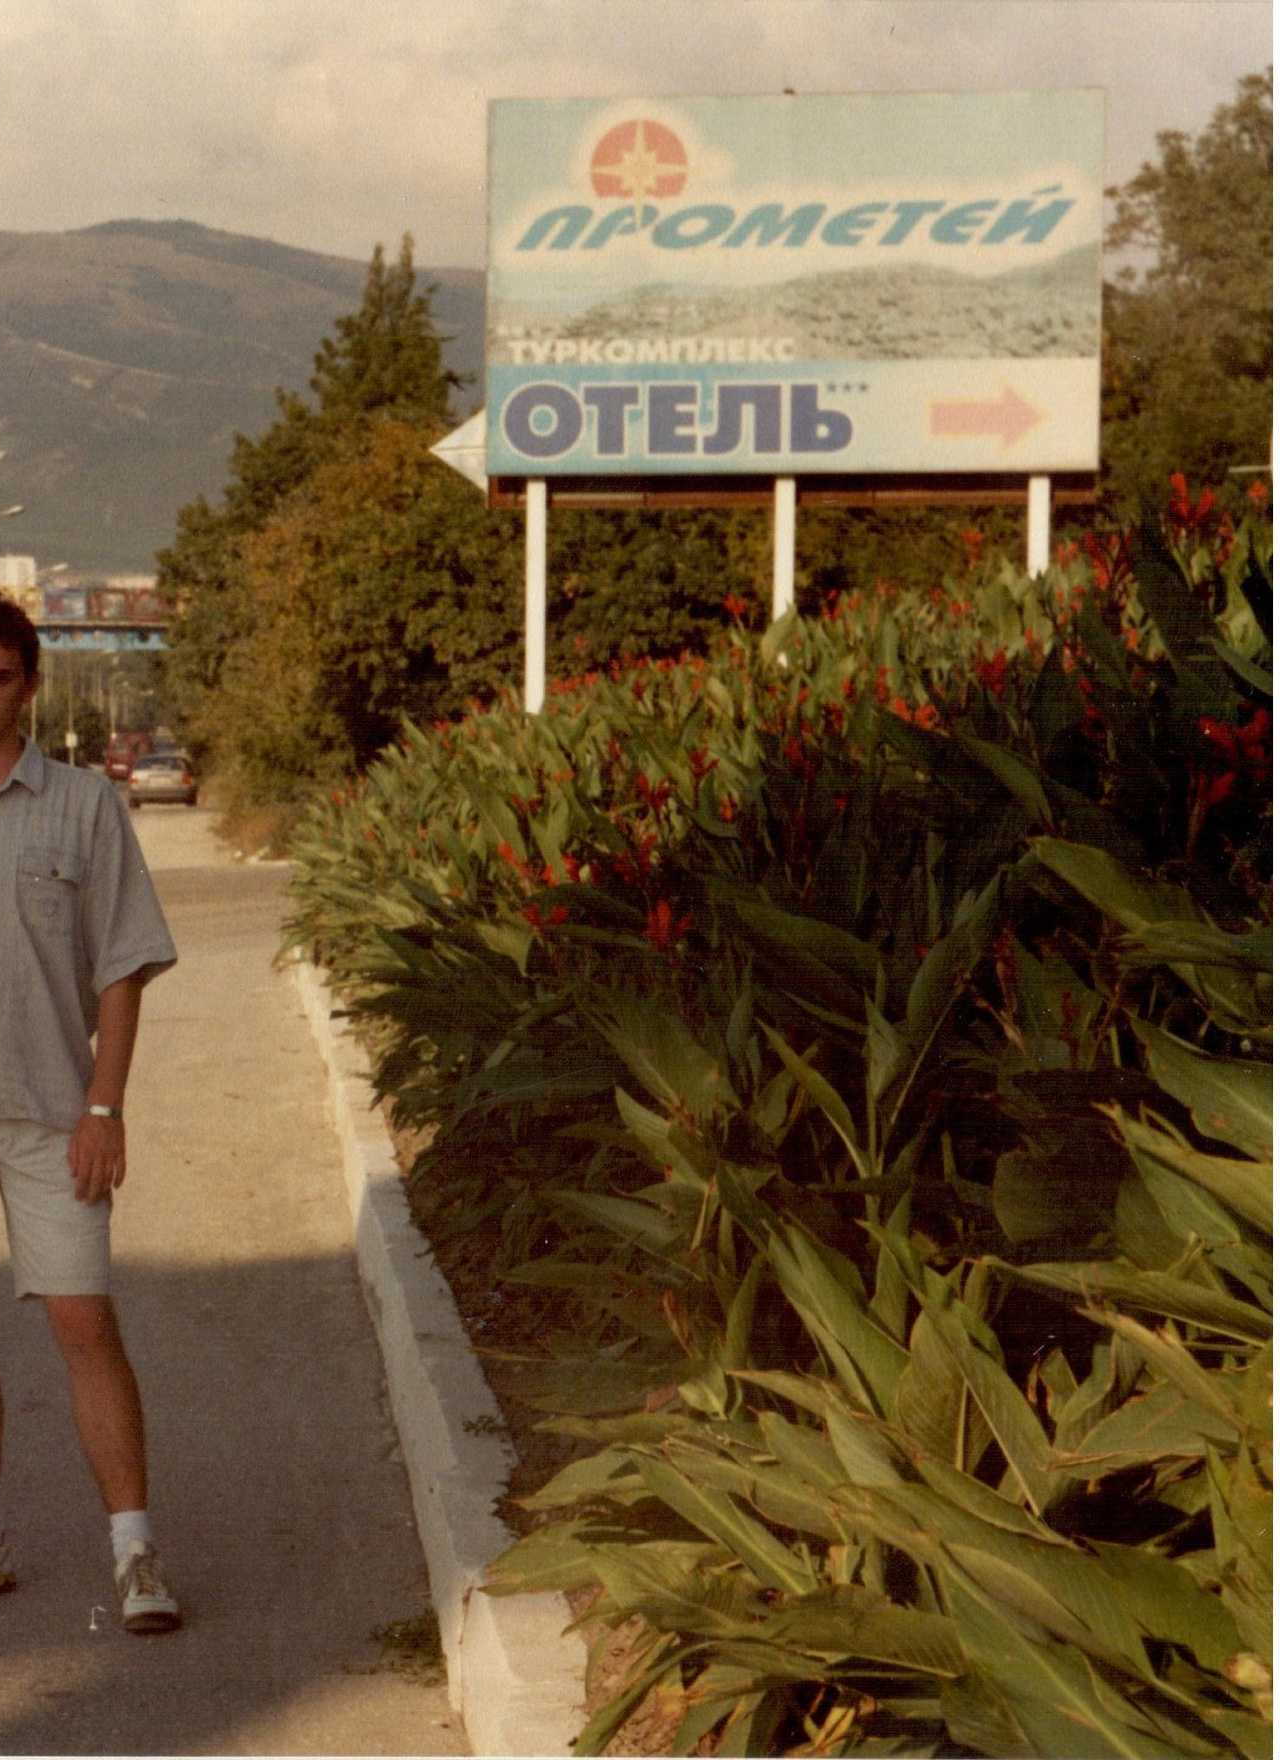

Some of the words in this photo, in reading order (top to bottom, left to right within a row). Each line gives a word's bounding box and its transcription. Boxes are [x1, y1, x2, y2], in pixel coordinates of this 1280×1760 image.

[515, 183, 1077, 250] ПРОМЕТЕЙ
[507, 337, 797, 364] ТУРКОМПЛЕКС
[503, 383, 854, 458] ОТЕЛЬ
